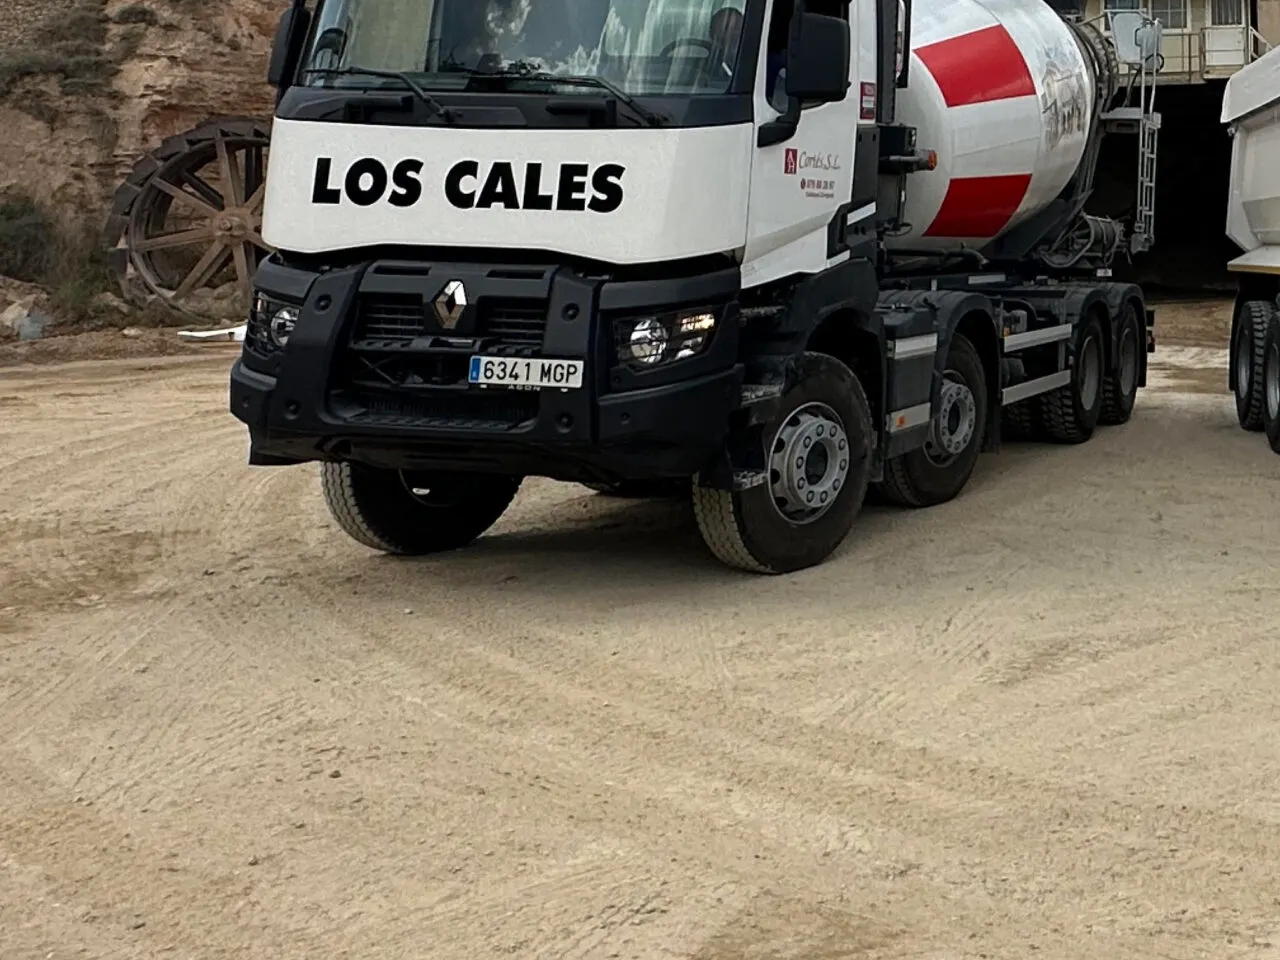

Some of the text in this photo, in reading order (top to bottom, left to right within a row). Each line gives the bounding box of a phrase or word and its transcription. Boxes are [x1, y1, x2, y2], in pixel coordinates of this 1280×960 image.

[312, 157, 626, 213] LOS CALES
[484, 361, 577, 383] 6341 MGP
